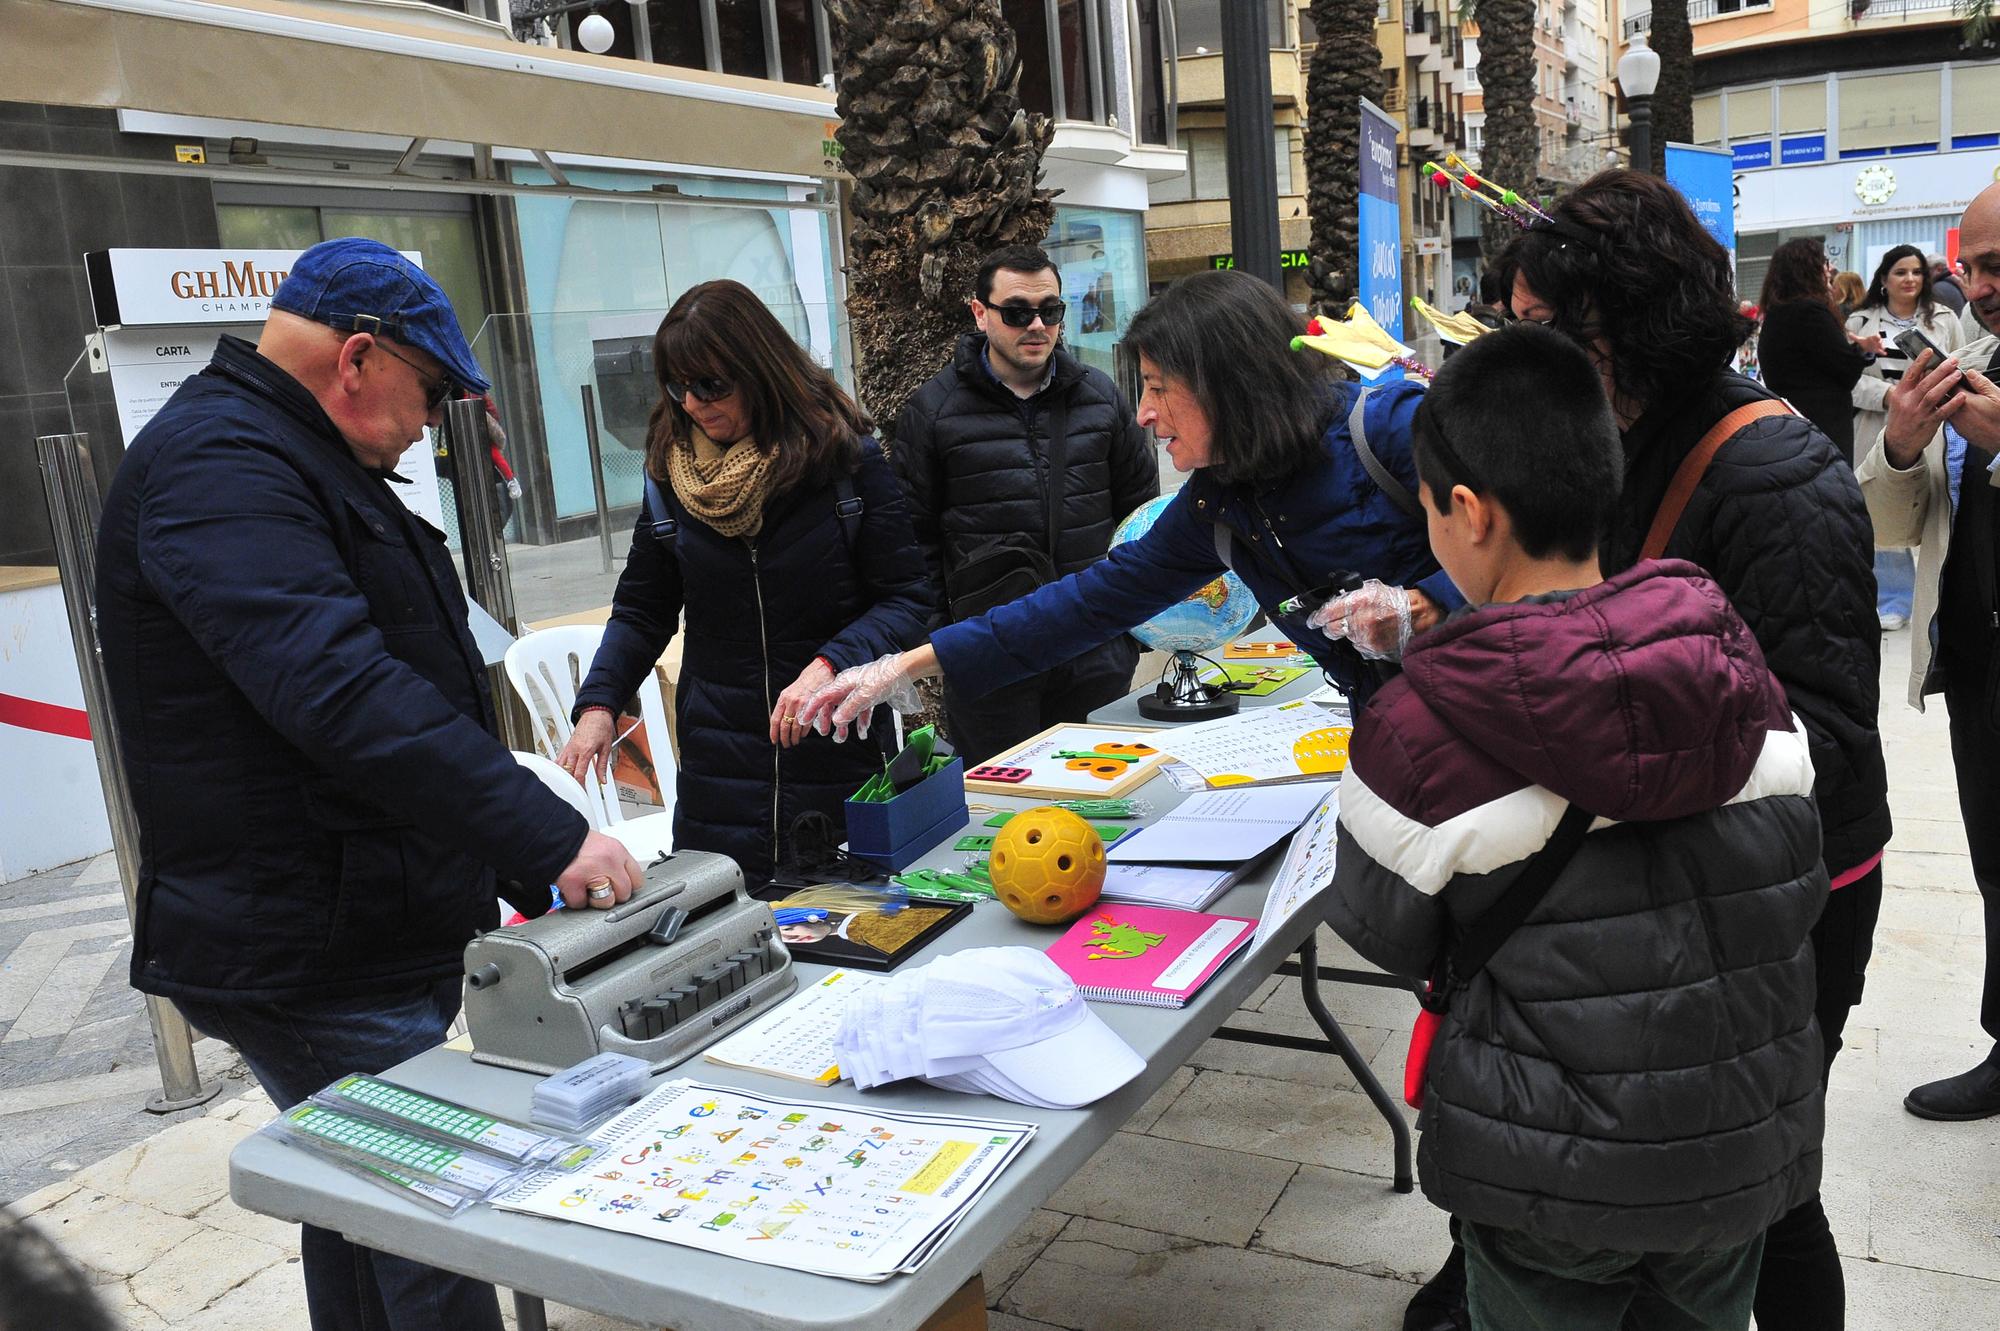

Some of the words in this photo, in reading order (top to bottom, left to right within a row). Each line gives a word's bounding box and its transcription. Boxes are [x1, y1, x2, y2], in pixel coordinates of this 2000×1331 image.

[1216, 253, 1308, 271] FACIA
[156, 345, 191, 357] CARTA
[477, 1137, 497, 1147] ONCE
[414, 1181, 434, 1193] ONCE
